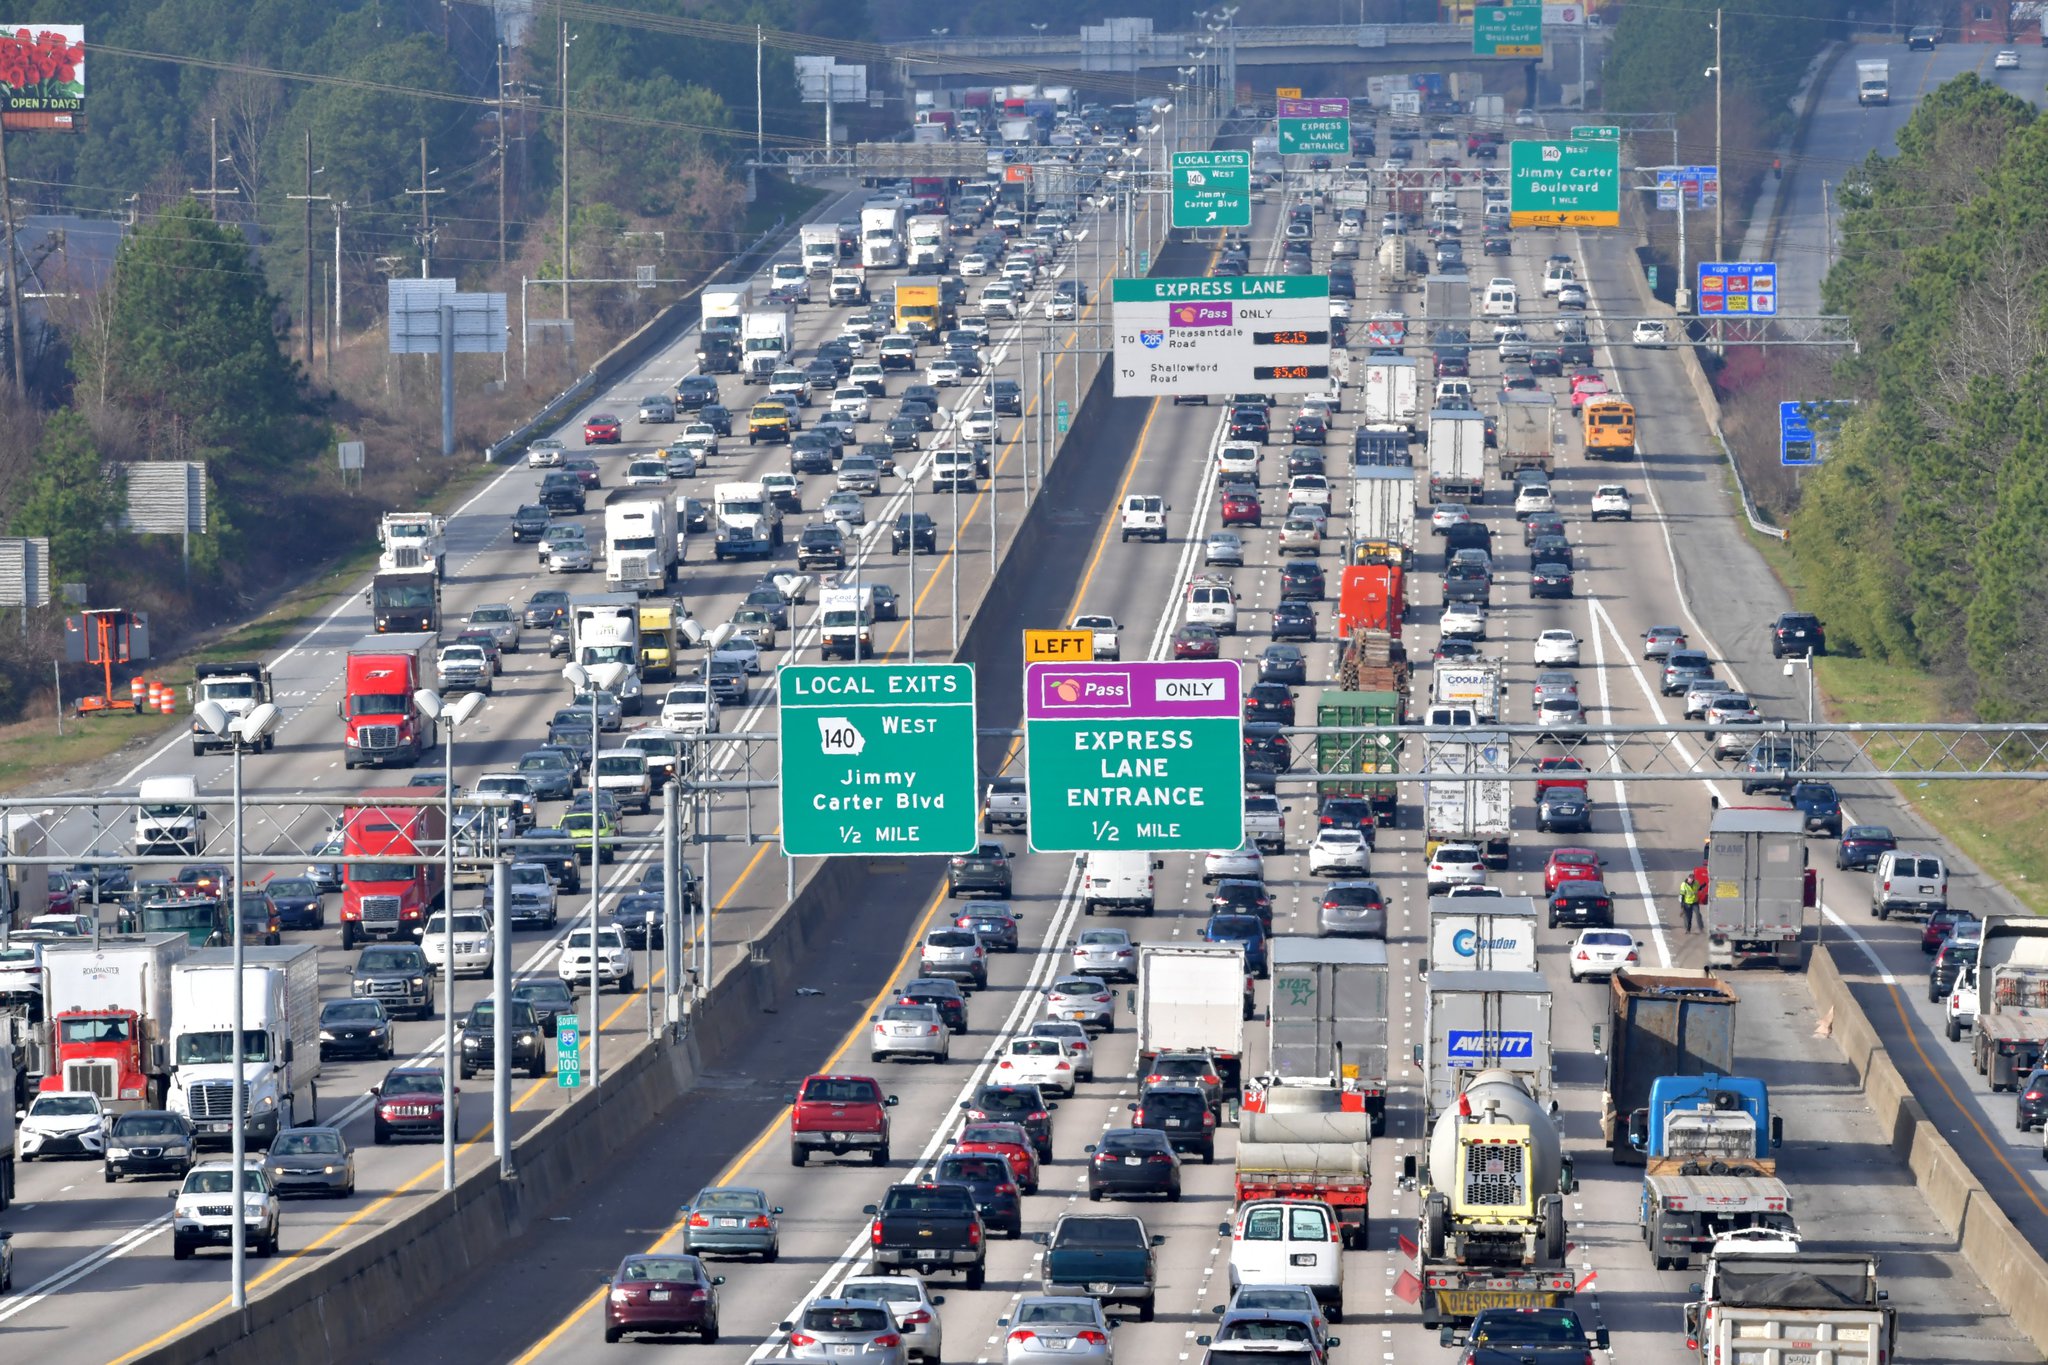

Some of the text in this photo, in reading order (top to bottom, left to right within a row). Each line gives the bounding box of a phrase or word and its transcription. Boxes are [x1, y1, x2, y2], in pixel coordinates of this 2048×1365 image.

[11, 98, 80, 109] OPEN 7 DAYS!
[1301, 122, 1341, 131] EXPRESS
[1310, 132, 1333, 141] LANE
[1299, 142, 1345, 150] ENTRANCE
[1178, 155, 1243, 164] LOCAL EXITS
[1544, 150, 1558, 159] 140
[1517, 168, 1613, 179] Jimmy Carter
[1189, 175, 1202, 184] 140
[1530, 182, 1599, 193] Boulevard
[1196, 191, 1226, 199] Jimmy
[1552, 196, 1556, 205] 1
[1155, 280, 1286, 296] EXPRESS LANE
[1199, 308, 1272, 319] Pass ONLY
[1120, 335, 1135, 344] TO
[1144, 334, 1162, 345] 285
[1169, 329, 1244, 338] Pleasantdale
[1169, 340, 1196, 348] Road
[1122, 370, 1136, 378] TO
[1150, 364, 1218, 372] Shallowford
[1150, 374, 1178, 384] Road
[1034, 638, 1084, 654] LEFT
[795, 675, 957, 694] LOCAL EXITS
[1084, 683, 1214, 696] Pass ONLY
[824, 716, 937, 748] 140 WEST
[1074, 730, 1193, 750] EXPRESS
[1101, 758, 1168, 778] LANE
[840, 770, 916, 787] Jimmy
[813, 793, 944, 810] Carter Blvd
[1067, 787, 1204, 807] ENTRANCE
[876, 826, 920, 842] MILE
[1137, 824, 1182, 838] MILE
[82, 966, 120, 975] ROADMASTER
[1278, 978, 1312, 990] STAR
[558, 1018, 578, 1026] SOUTH
[562, 1032, 574, 1042] 85
[1452, 1036, 1530, 1052] AVERITT
[559, 1050, 578, 1058] MILE
[560, 1060, 578, 1070] 100
[564, 1074, 573, 1086] .6
[1472, 1174, 1517, 1184] TEREX
[1450, 1293, 1511, 1312] OVERSIZE
